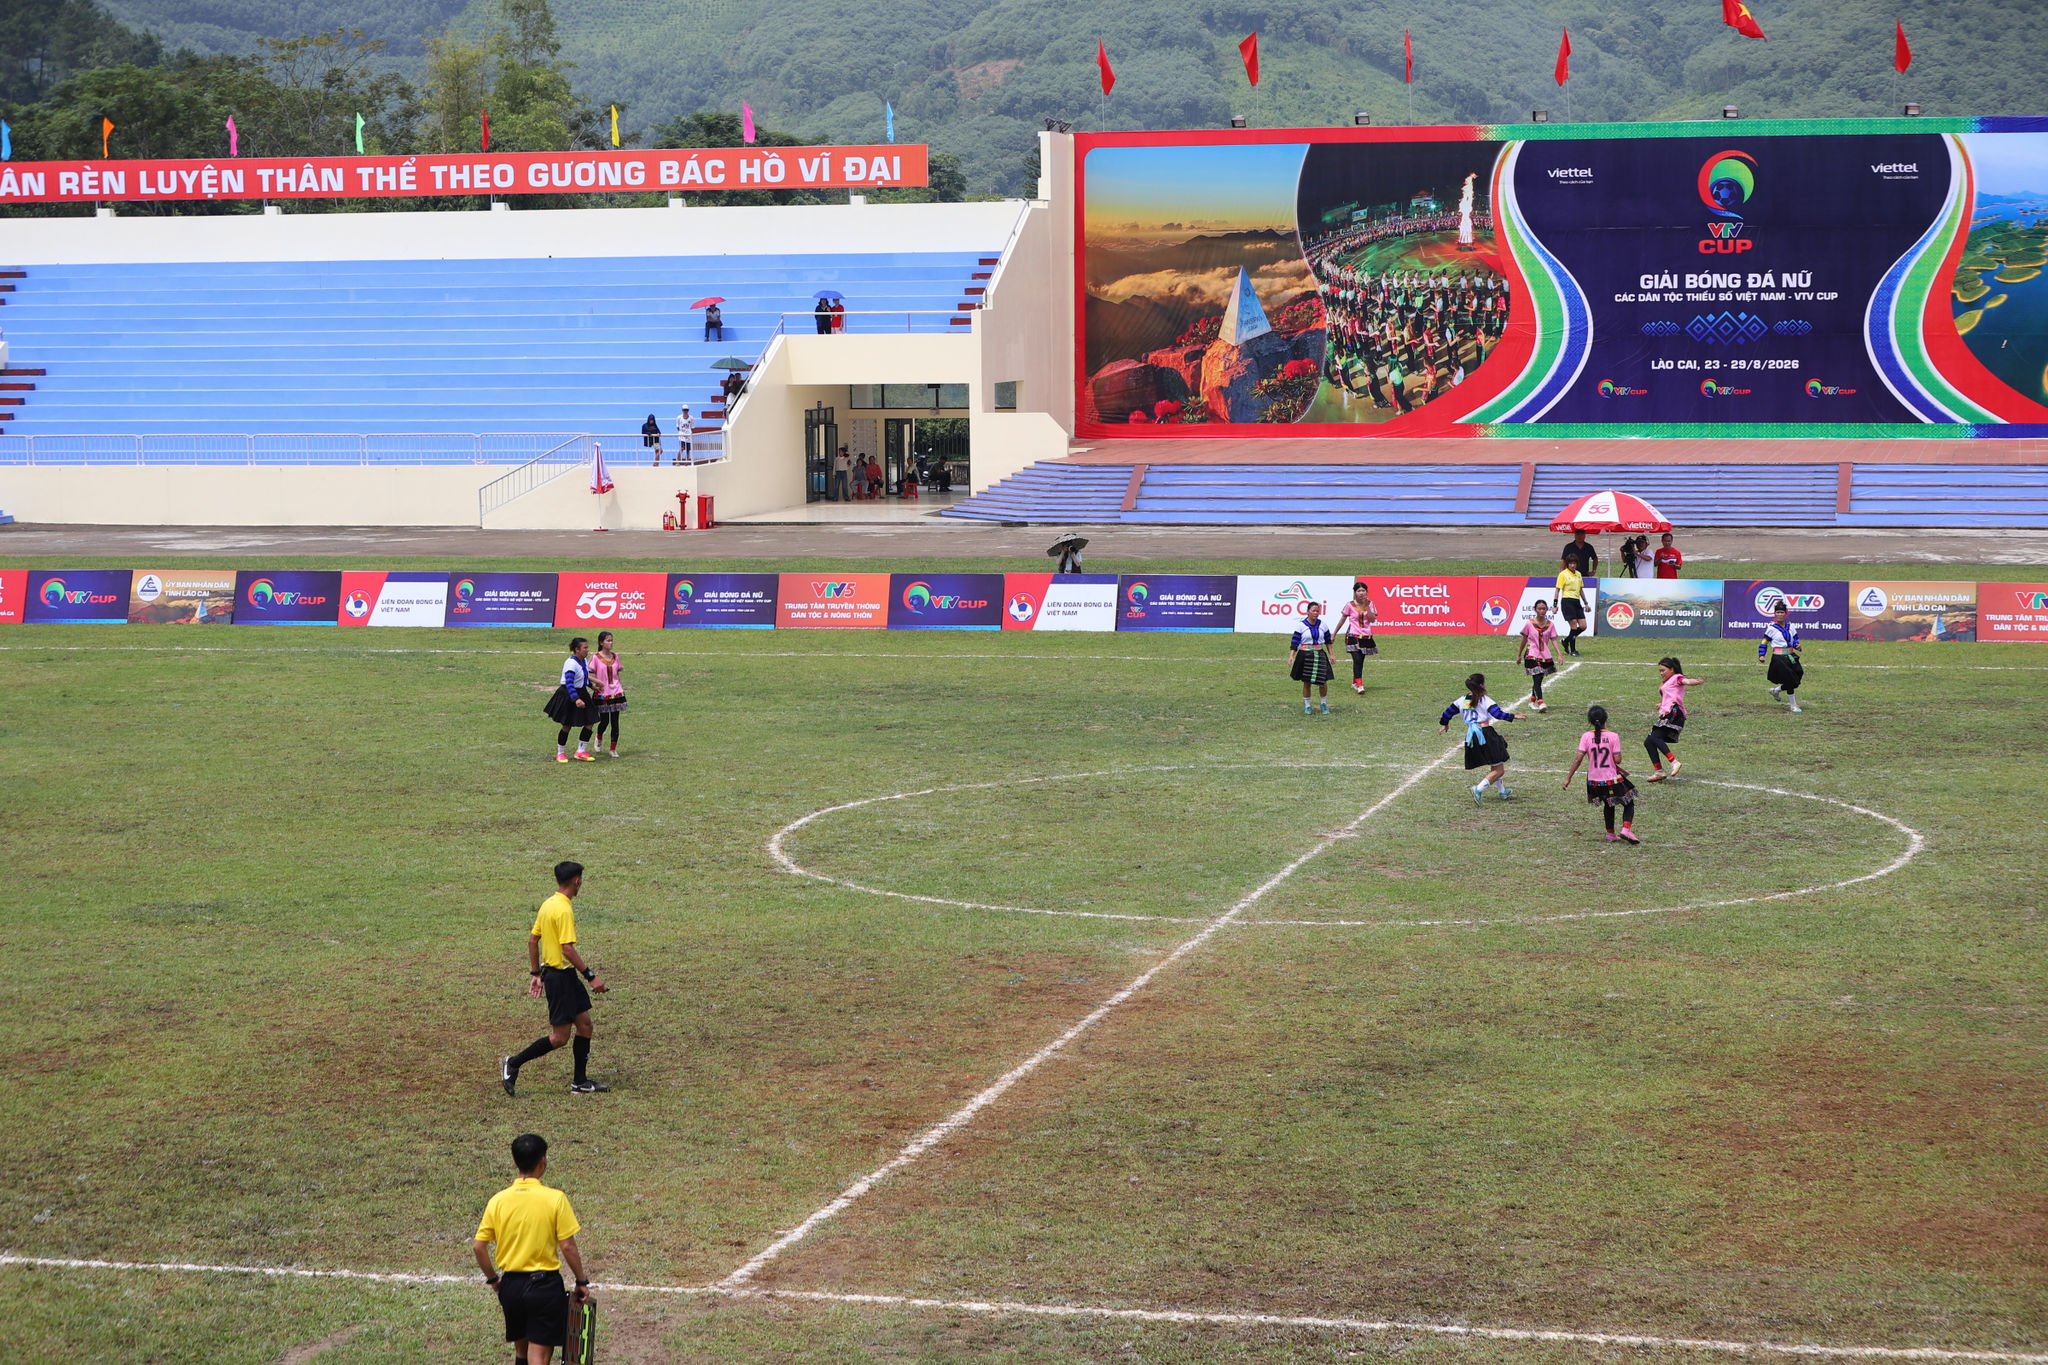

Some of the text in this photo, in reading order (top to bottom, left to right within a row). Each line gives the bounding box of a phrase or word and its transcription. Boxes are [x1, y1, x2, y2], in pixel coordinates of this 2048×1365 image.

[1547, 167, 1594, 178] viettel
[1871, 163, 1919, 173] viettel
[59, 165, 126, 195] RÈN
[139, 164, 244, 198] LUYỆN
[257, 163, 344, 193] THÂN
[357, 157, 417, 191] THỂ
[430, 163, 515, 189] THEO
[528, 160, 646, 188] GƯƠNG
[659, 154, 725, 185] BÁC
[740, 150, 786, 183] HỒ
[798, 152, 832, 182] VĨ
[843, 156, 900, 185] ĐẠI
[1707, 222, 1744, 238] VTV
[1698, 239, 1753, 254] CUP
[1640, 269, 1813, 289] GIẢI BÓNG ĐÁ NỮ
[1614, 292, 1635, 302] CÁC
[1638, 292, 1660, 302] DÂN
[1663, 292, 1683, 303] TỘC
[1686, 290, 1716, 302] THIỂU
[1719, 290, 1733, 301] SỐ
[1735, 291, 1758, 303] VIỆT
[1760, 292, 1786, 301] NAM
[1794, 292, 1815, 301] VTV
[1816, 292, 1838, 301] CUP
[1651, 358, 1674, 370] LÀO
[1677, 360, 1701, 371] CAI,
[1704, 360, 1720, 370] 23
[1730, 359, 1800, 370] 29/8/2026
[1588, 504, 1610, 515] 5G
[621, 591, 646, 600] CUỘC
[811, 582, 856, 598] VTV5
[1383, 584, 1450, 598] viettel
[65, 591, 117, 604] VTV CUP
[273, 592, 326, 605] VTV CUP
[930, 596, 987, 608] VTV CUP
[1786, 596, 1822, 607] VTV6
[1924, 592, 1950, 601] NHÂN
[1951, 592, 1970, 602] DÂN
[576, 592, 618, 619] 5G
[620, 600, 646, 610] SỐNG
[856, 602, 880, 610] THÔNG
[1262, 600, 1292, 615] Lao
[1912, 603, 1930, 611] LÀO
[619, 611, 637, 620] MỚI
[1703, 609, 1714, 618] LỘ
[1660, 618, 1676, 626] LÀO
[1678, 619, 1691, 627] CAI
[1728, 621, 1750, 629] KÊNH
[1805, 621, 1819, 629] THỂ
[2013, 624, 2029, 632] TỘC
[1590, 746, 1610, 768] 12
